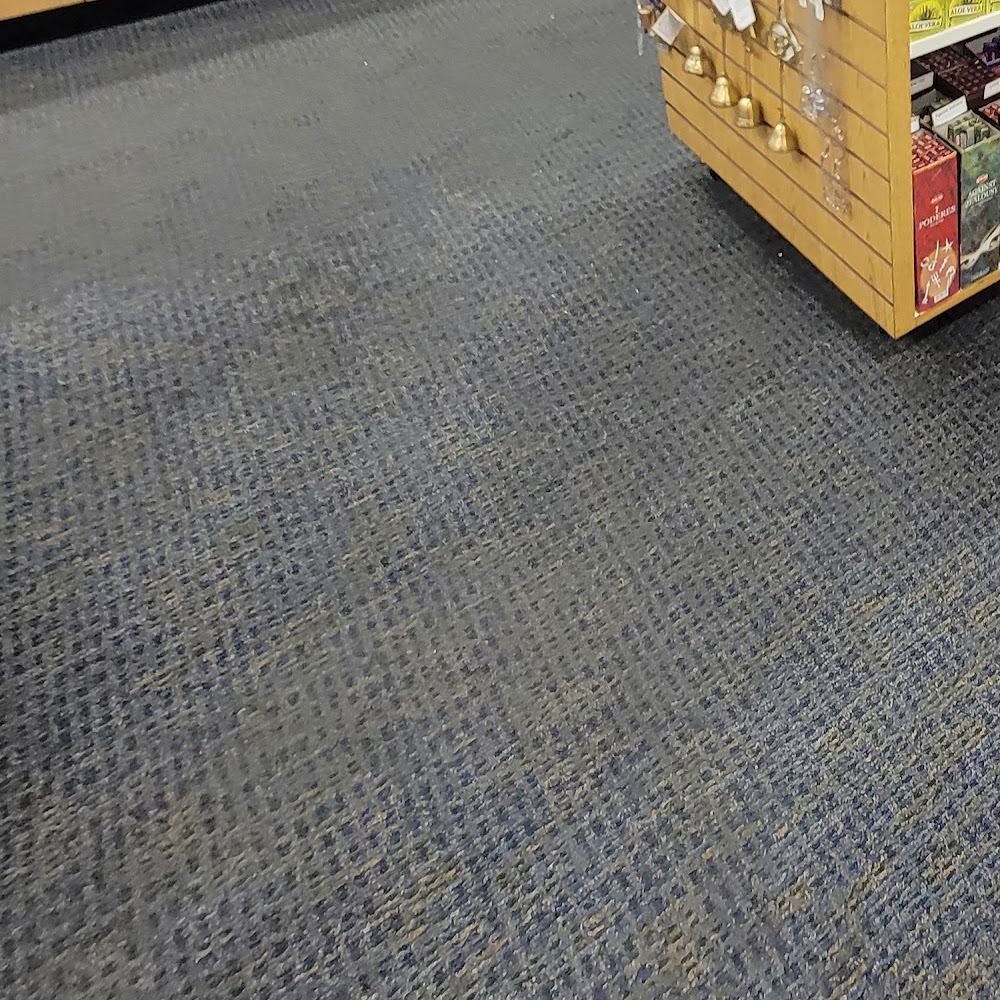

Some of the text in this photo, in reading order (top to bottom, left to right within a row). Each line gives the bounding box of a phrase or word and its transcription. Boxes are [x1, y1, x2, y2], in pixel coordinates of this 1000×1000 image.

[950, 4, 982, 16] ALOE VERA
[964, 186, 999, 209] JEALOUSY
[968, 178, 997, 199] AGAINST
[918, 204, 956, 230] PODERES
